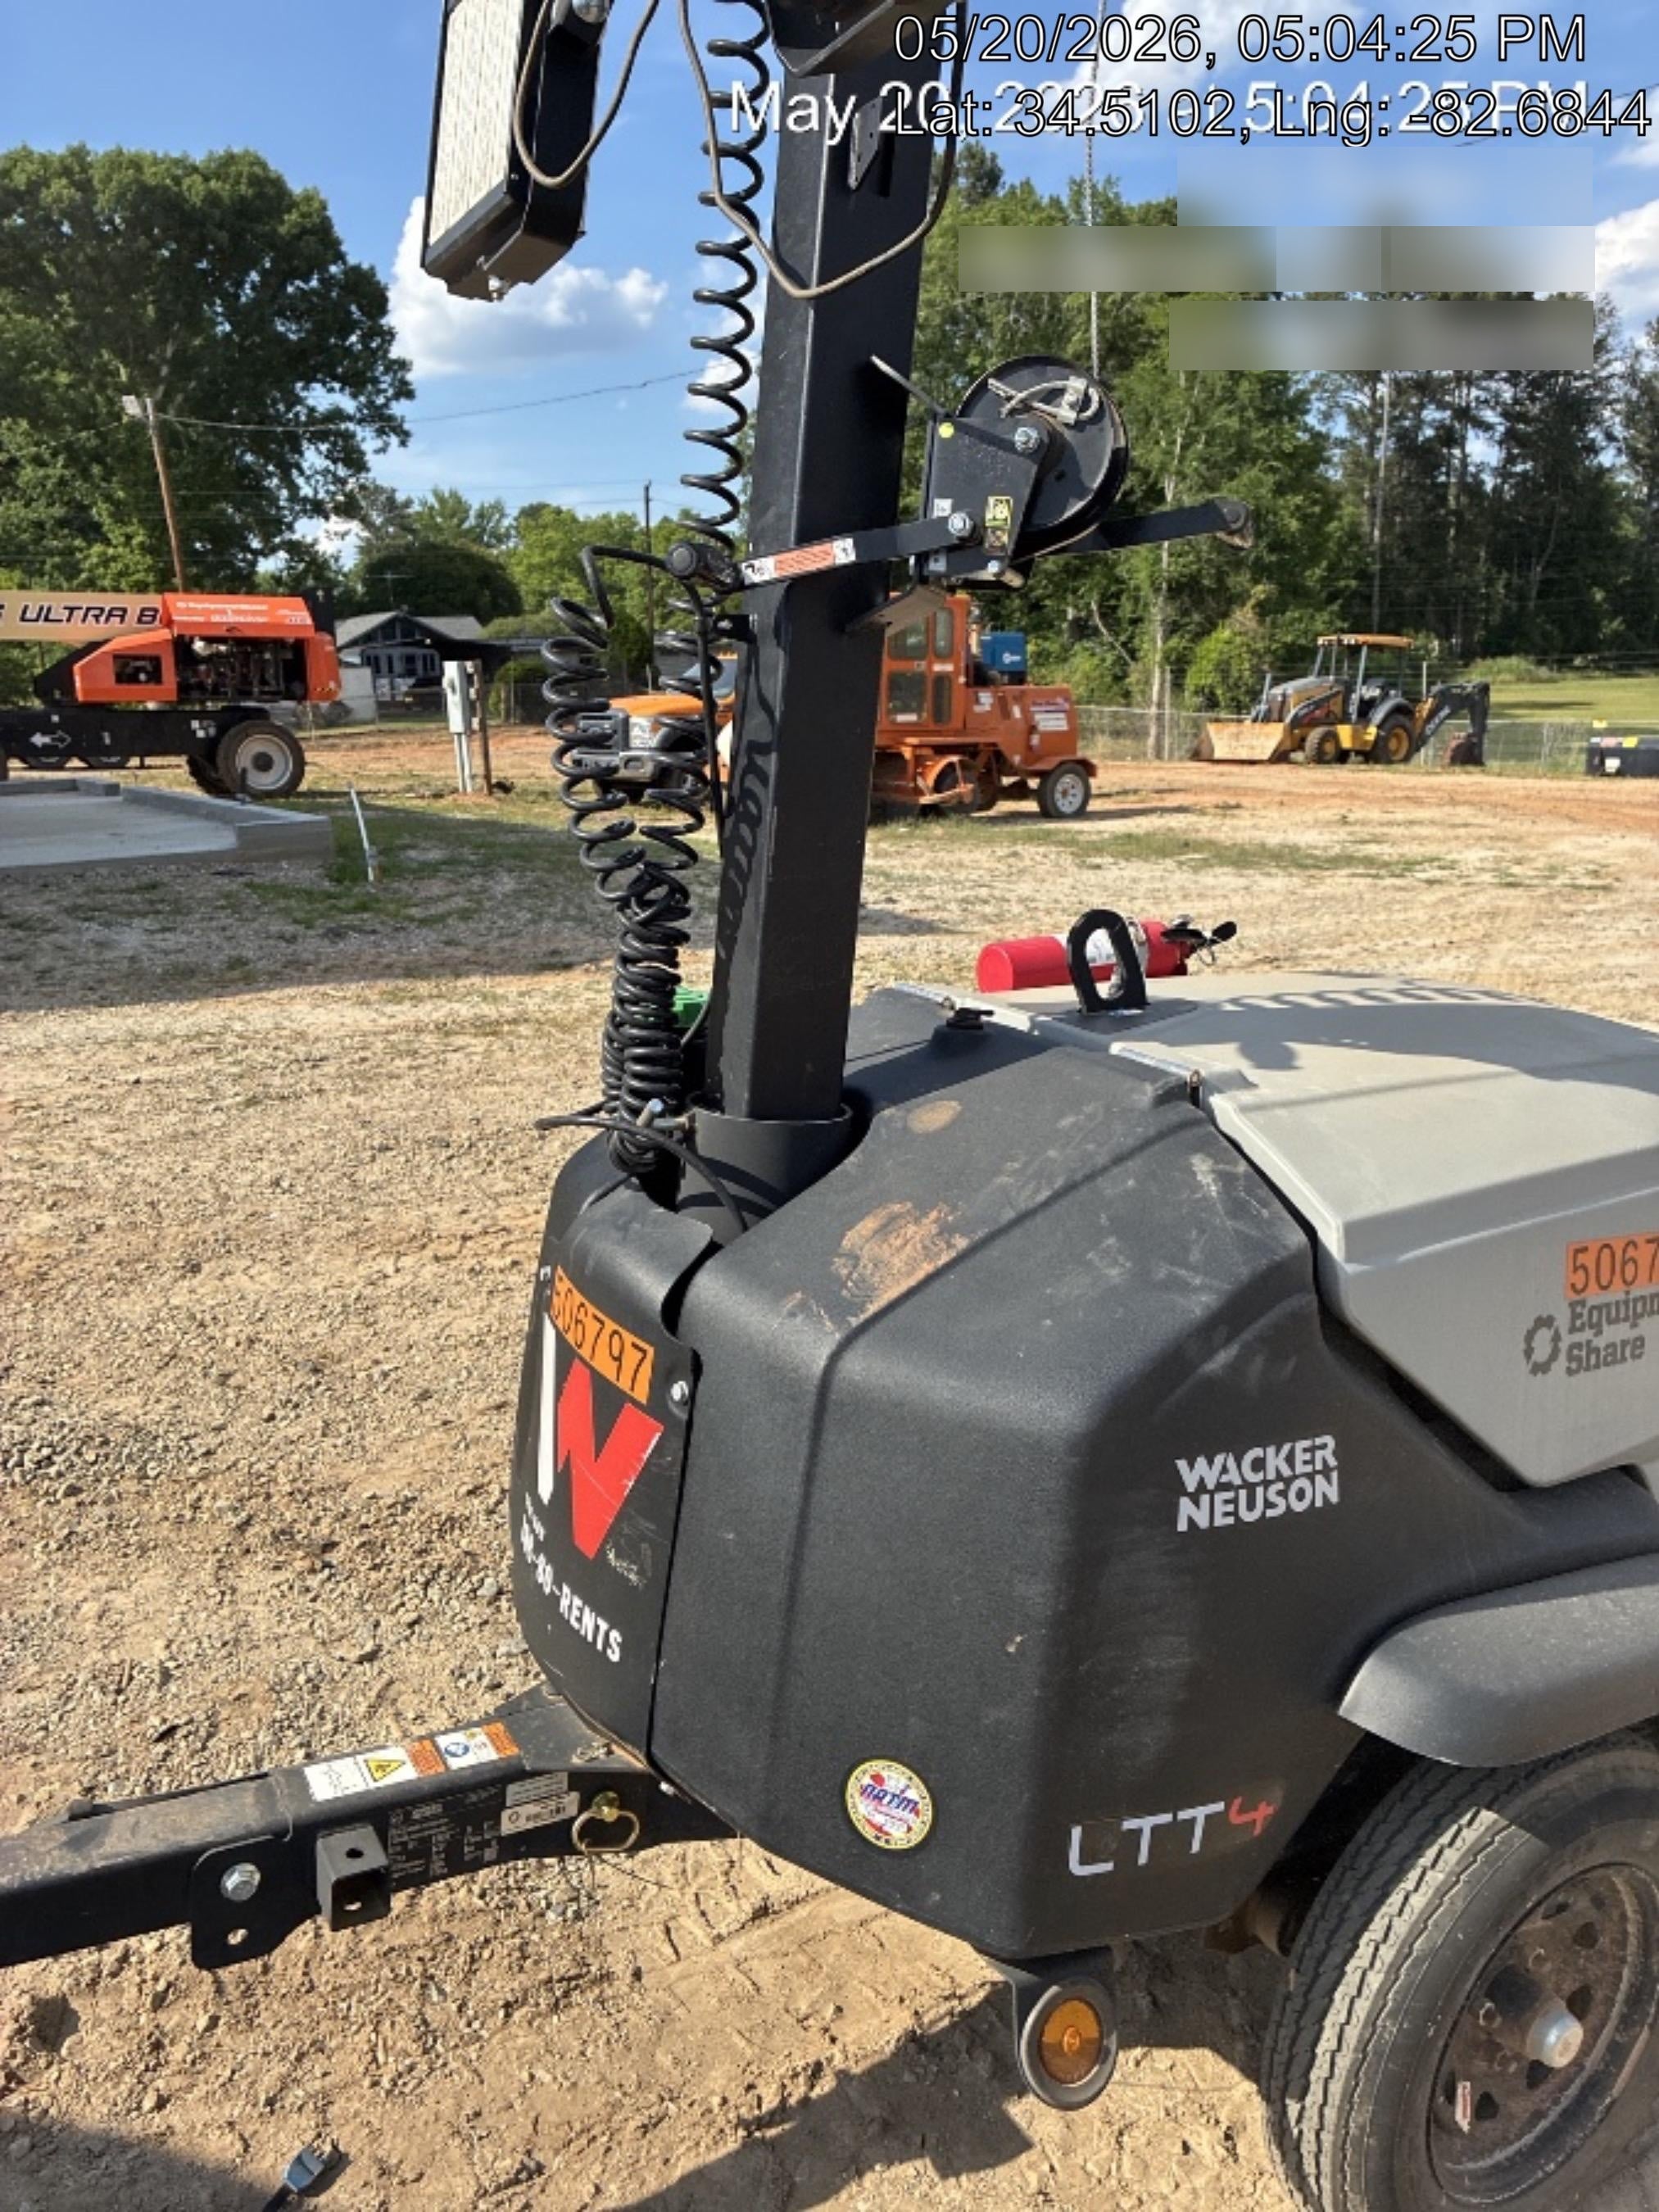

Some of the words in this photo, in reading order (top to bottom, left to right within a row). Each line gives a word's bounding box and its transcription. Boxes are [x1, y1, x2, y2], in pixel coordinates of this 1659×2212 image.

[19, 604, 128, 625] ULTRA
[1570, 1235, 1659, 1295] 5067
[552, 1274, 648, 1393] 506797
[1566, 1334, 1645, 1377] Share
[1175, 1435, 1338, 1493] WACKER
[1176, 1470, 1339, 1532] NEUSON
[1068, 1796, 1277, 1876] LTT4
